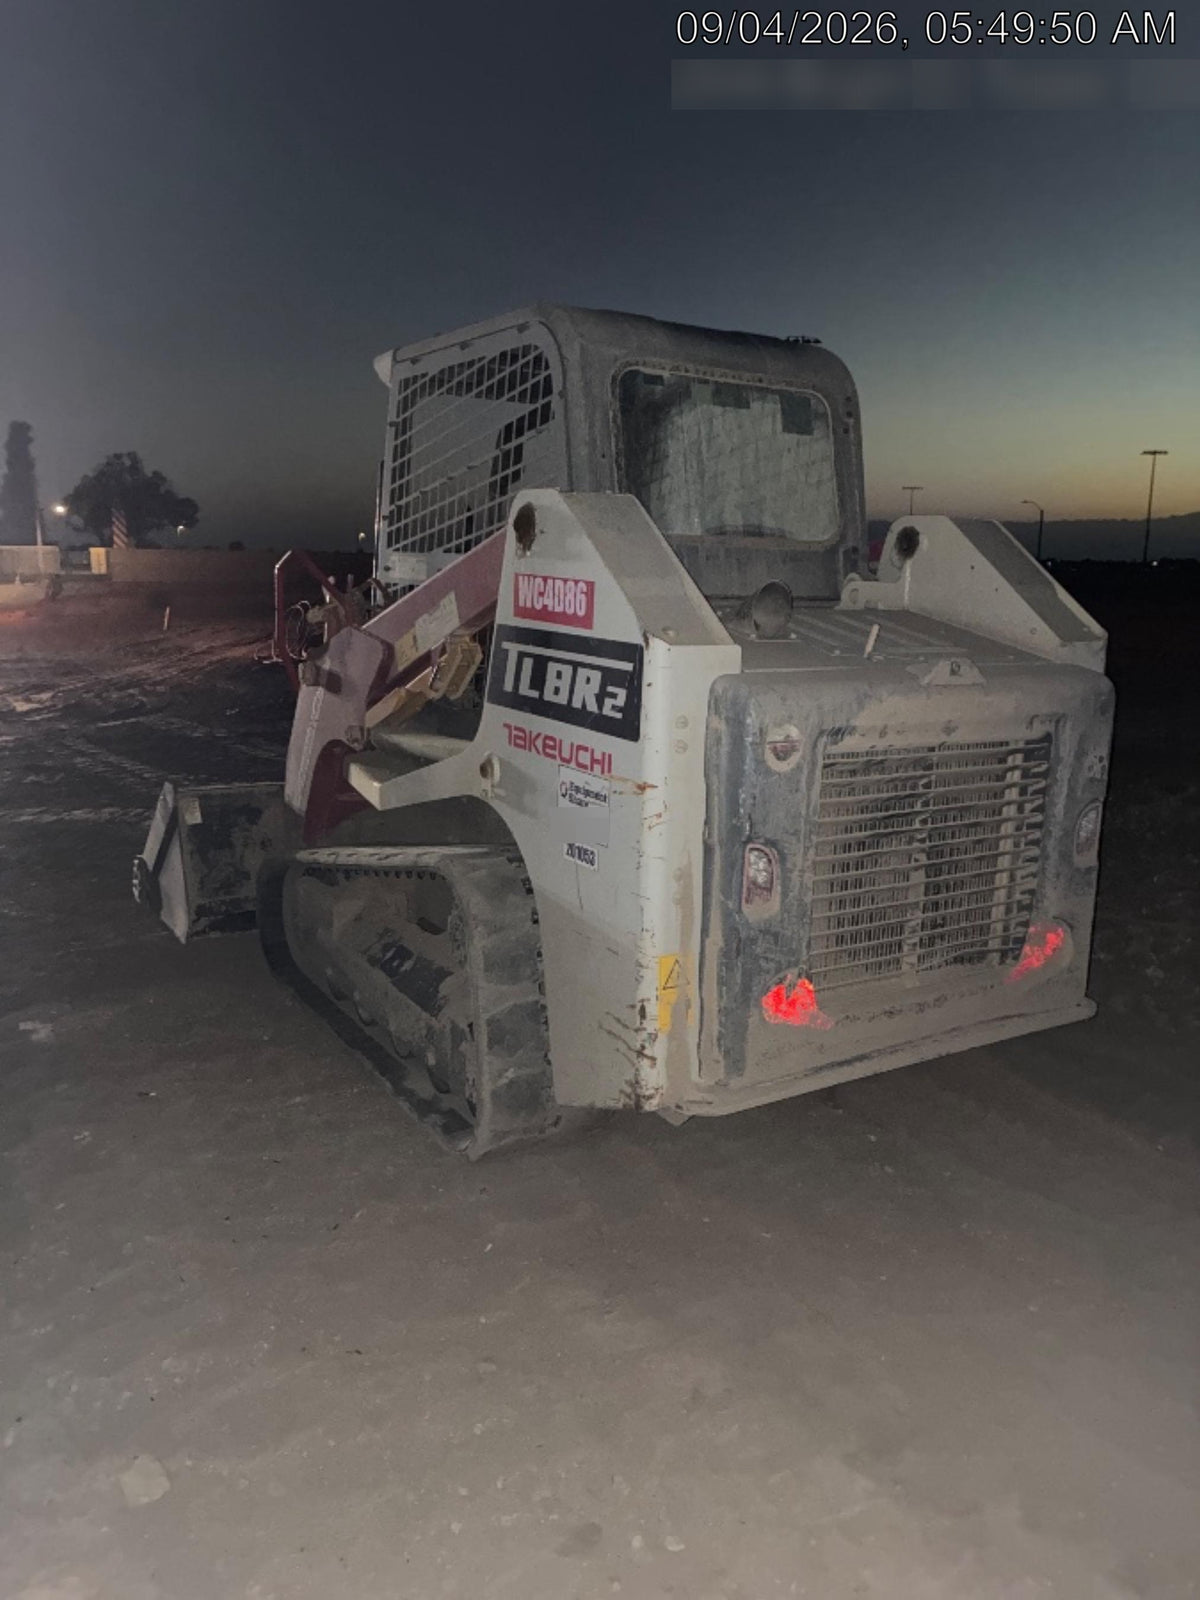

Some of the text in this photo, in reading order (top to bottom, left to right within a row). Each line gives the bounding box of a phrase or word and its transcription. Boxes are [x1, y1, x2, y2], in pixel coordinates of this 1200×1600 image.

[518, 574, 588, 617] WC4D86
[501, 640, 633, 719] TL8R2
[502, 722, 612, 775] TAKEUCHI
